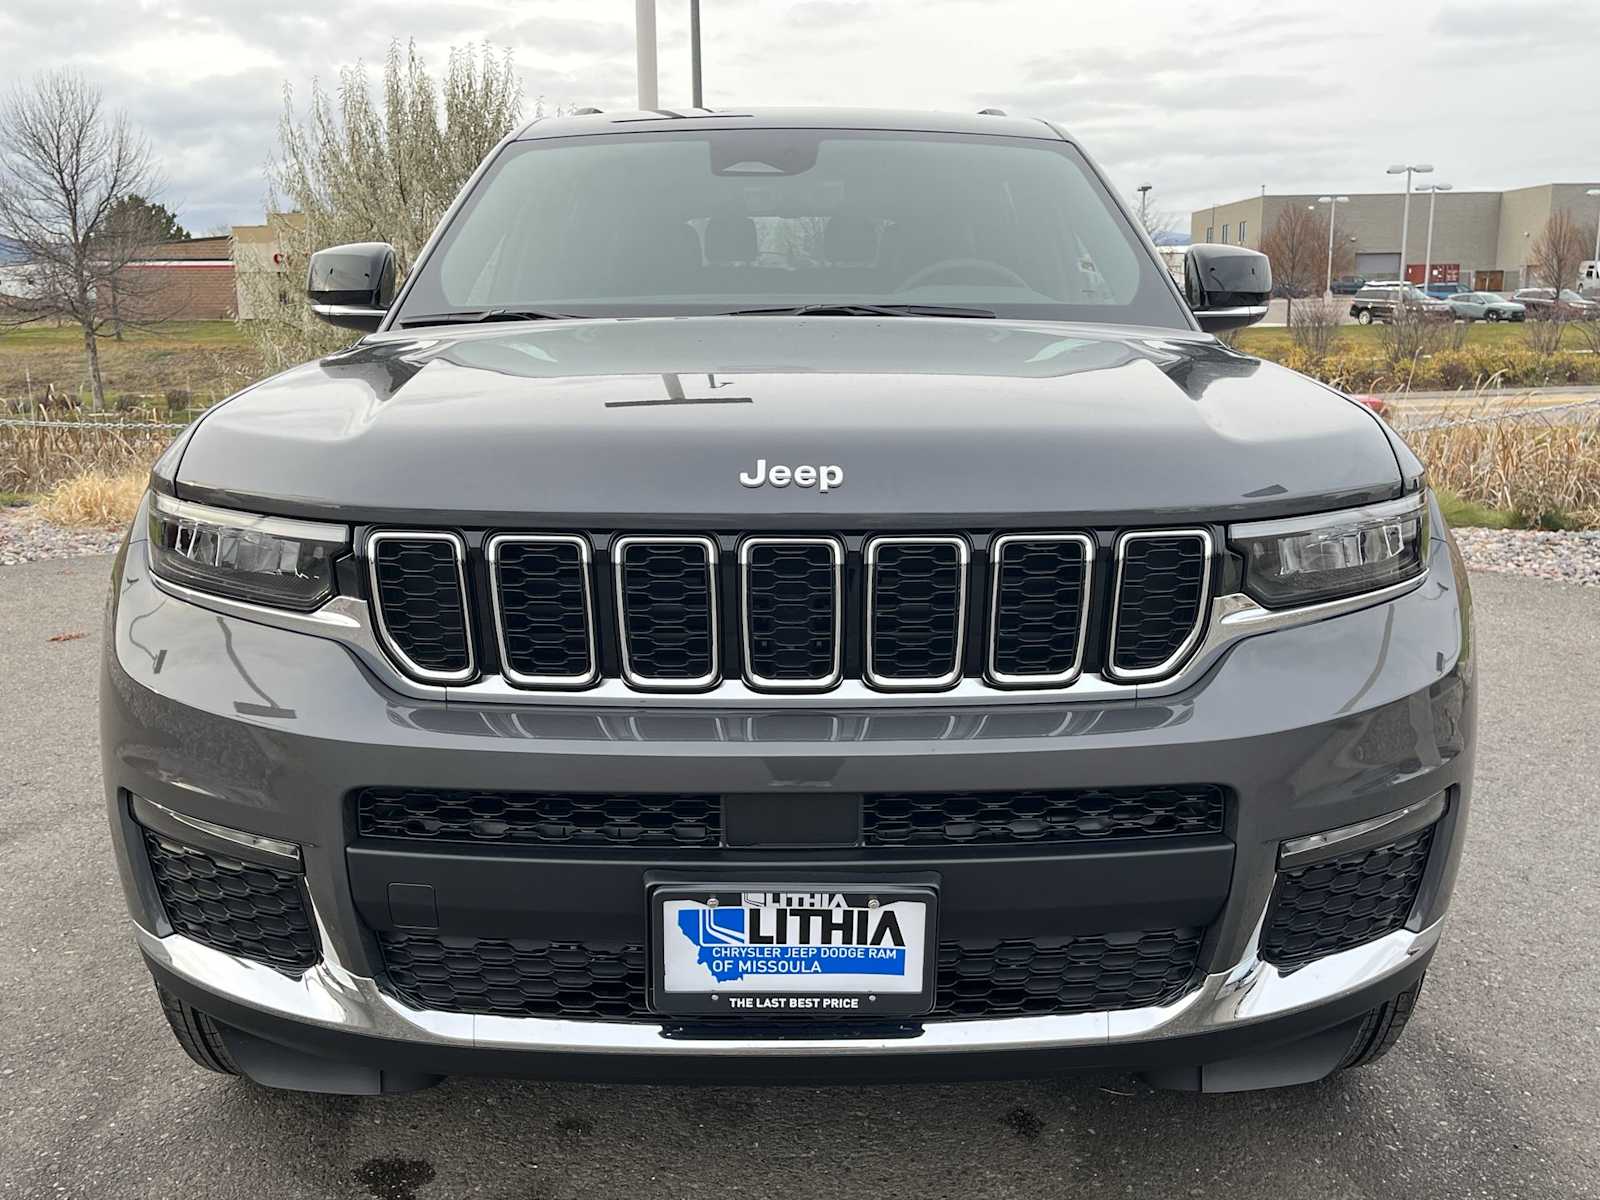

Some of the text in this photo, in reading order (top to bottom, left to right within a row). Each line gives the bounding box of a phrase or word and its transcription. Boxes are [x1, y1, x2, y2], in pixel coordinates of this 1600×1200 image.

[739, 459, 844, 493] Jeep
[764, 893, 849, 908] LITHIA
[749, 909, 906, 946] LITHIA
[712, 947, 897, 959] CHRYSLER JEEP DODGE RAM
[712, 960, 822, 973] OF MISSOULA
[729, 998, 859, 1009] THE LAST BEST PRICE
